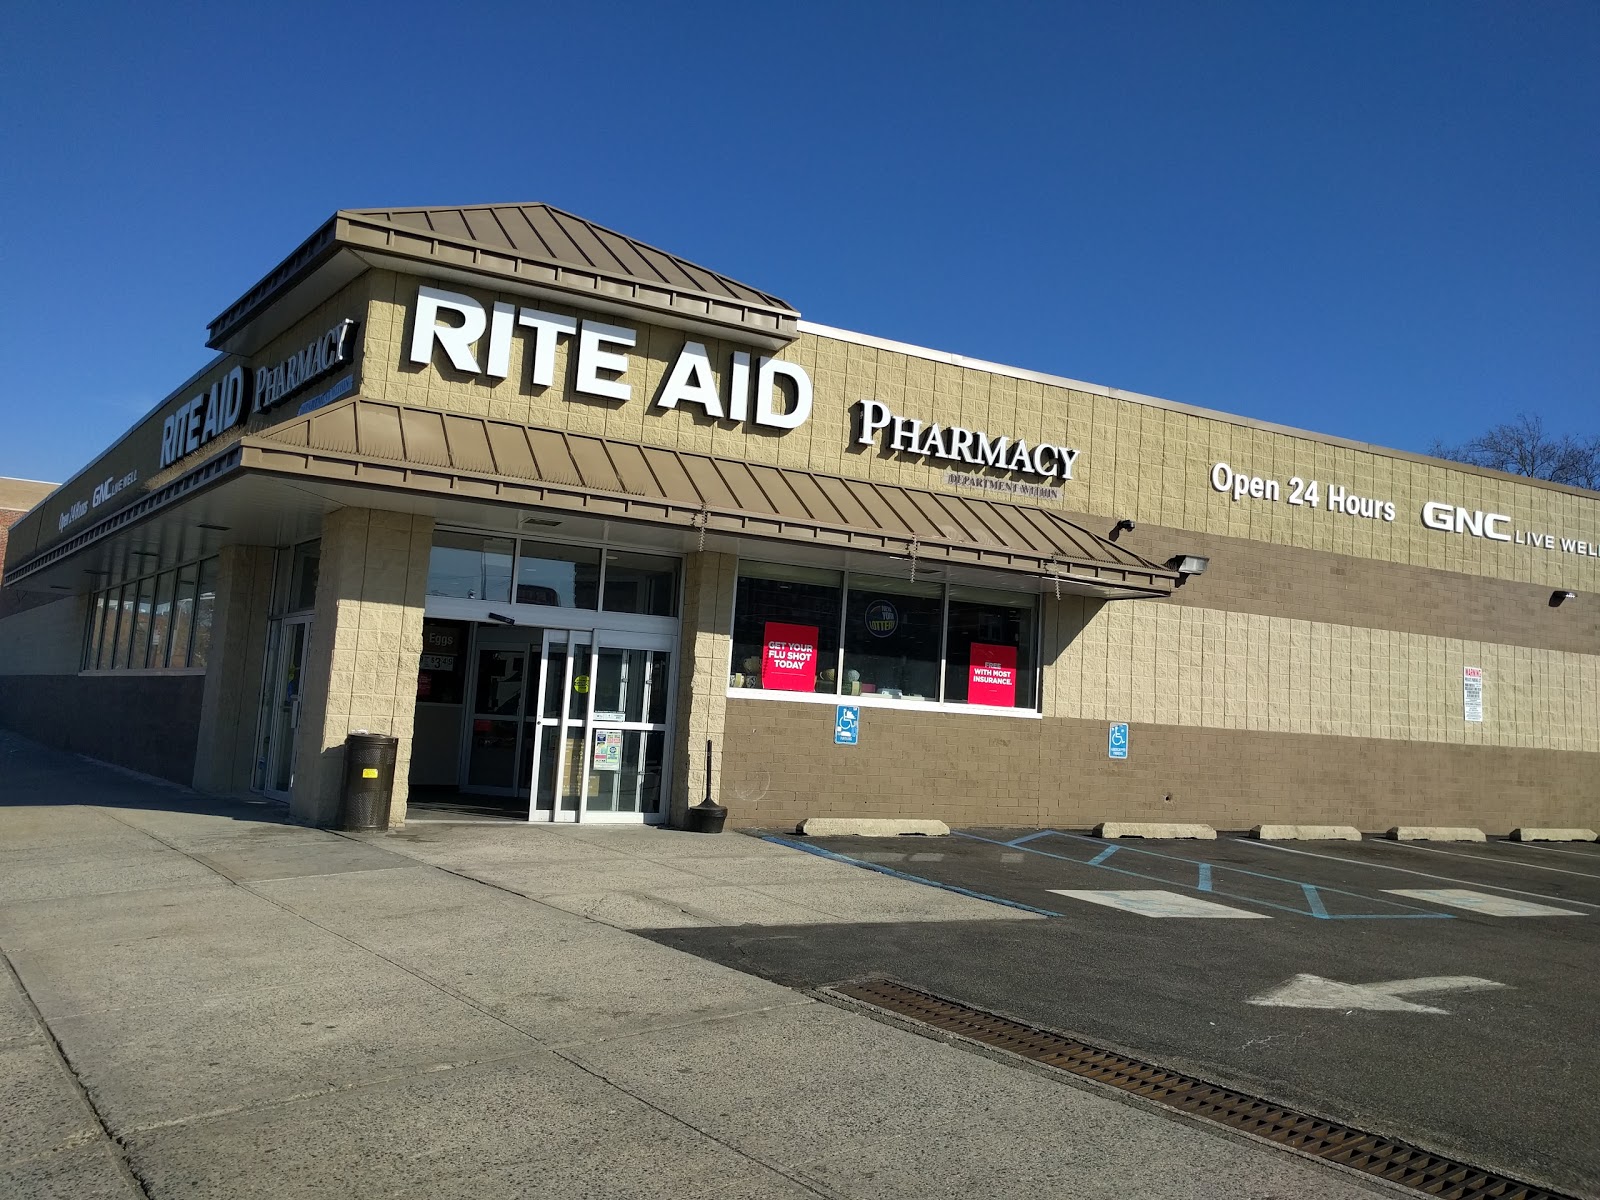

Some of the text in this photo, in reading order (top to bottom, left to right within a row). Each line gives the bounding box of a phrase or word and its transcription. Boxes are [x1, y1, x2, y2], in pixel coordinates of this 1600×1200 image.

[252, 318, 354, 413] PHARMACY
[409, 284, 814, 430] RITE AID
[159, 365, 244, 469] RITE AID
[859, 399, 1081, 480] PHARMACY
[92, 476, 114, 508] GNC
[947, 473, 1019, 495] DEPARTMENT
[1212, 463, 1396, 522] Open 24 Hours
[1422, 501, 1600, 558] GNC LIVE WEL
[869, 620, 896, 631] LOTTERY
[429, 632, 453, 646] Eggs
[768, 641, 813, 653] GET YOUR
[768, 650, 812, 661] FLU SHOT
[774, 660, 804, 669] TODAY
[974, 668, 1011, 678] WITH MOST
[984, 662, 1002, 670] FREE
[973, 676, 1012, 686] INSURANCE.
